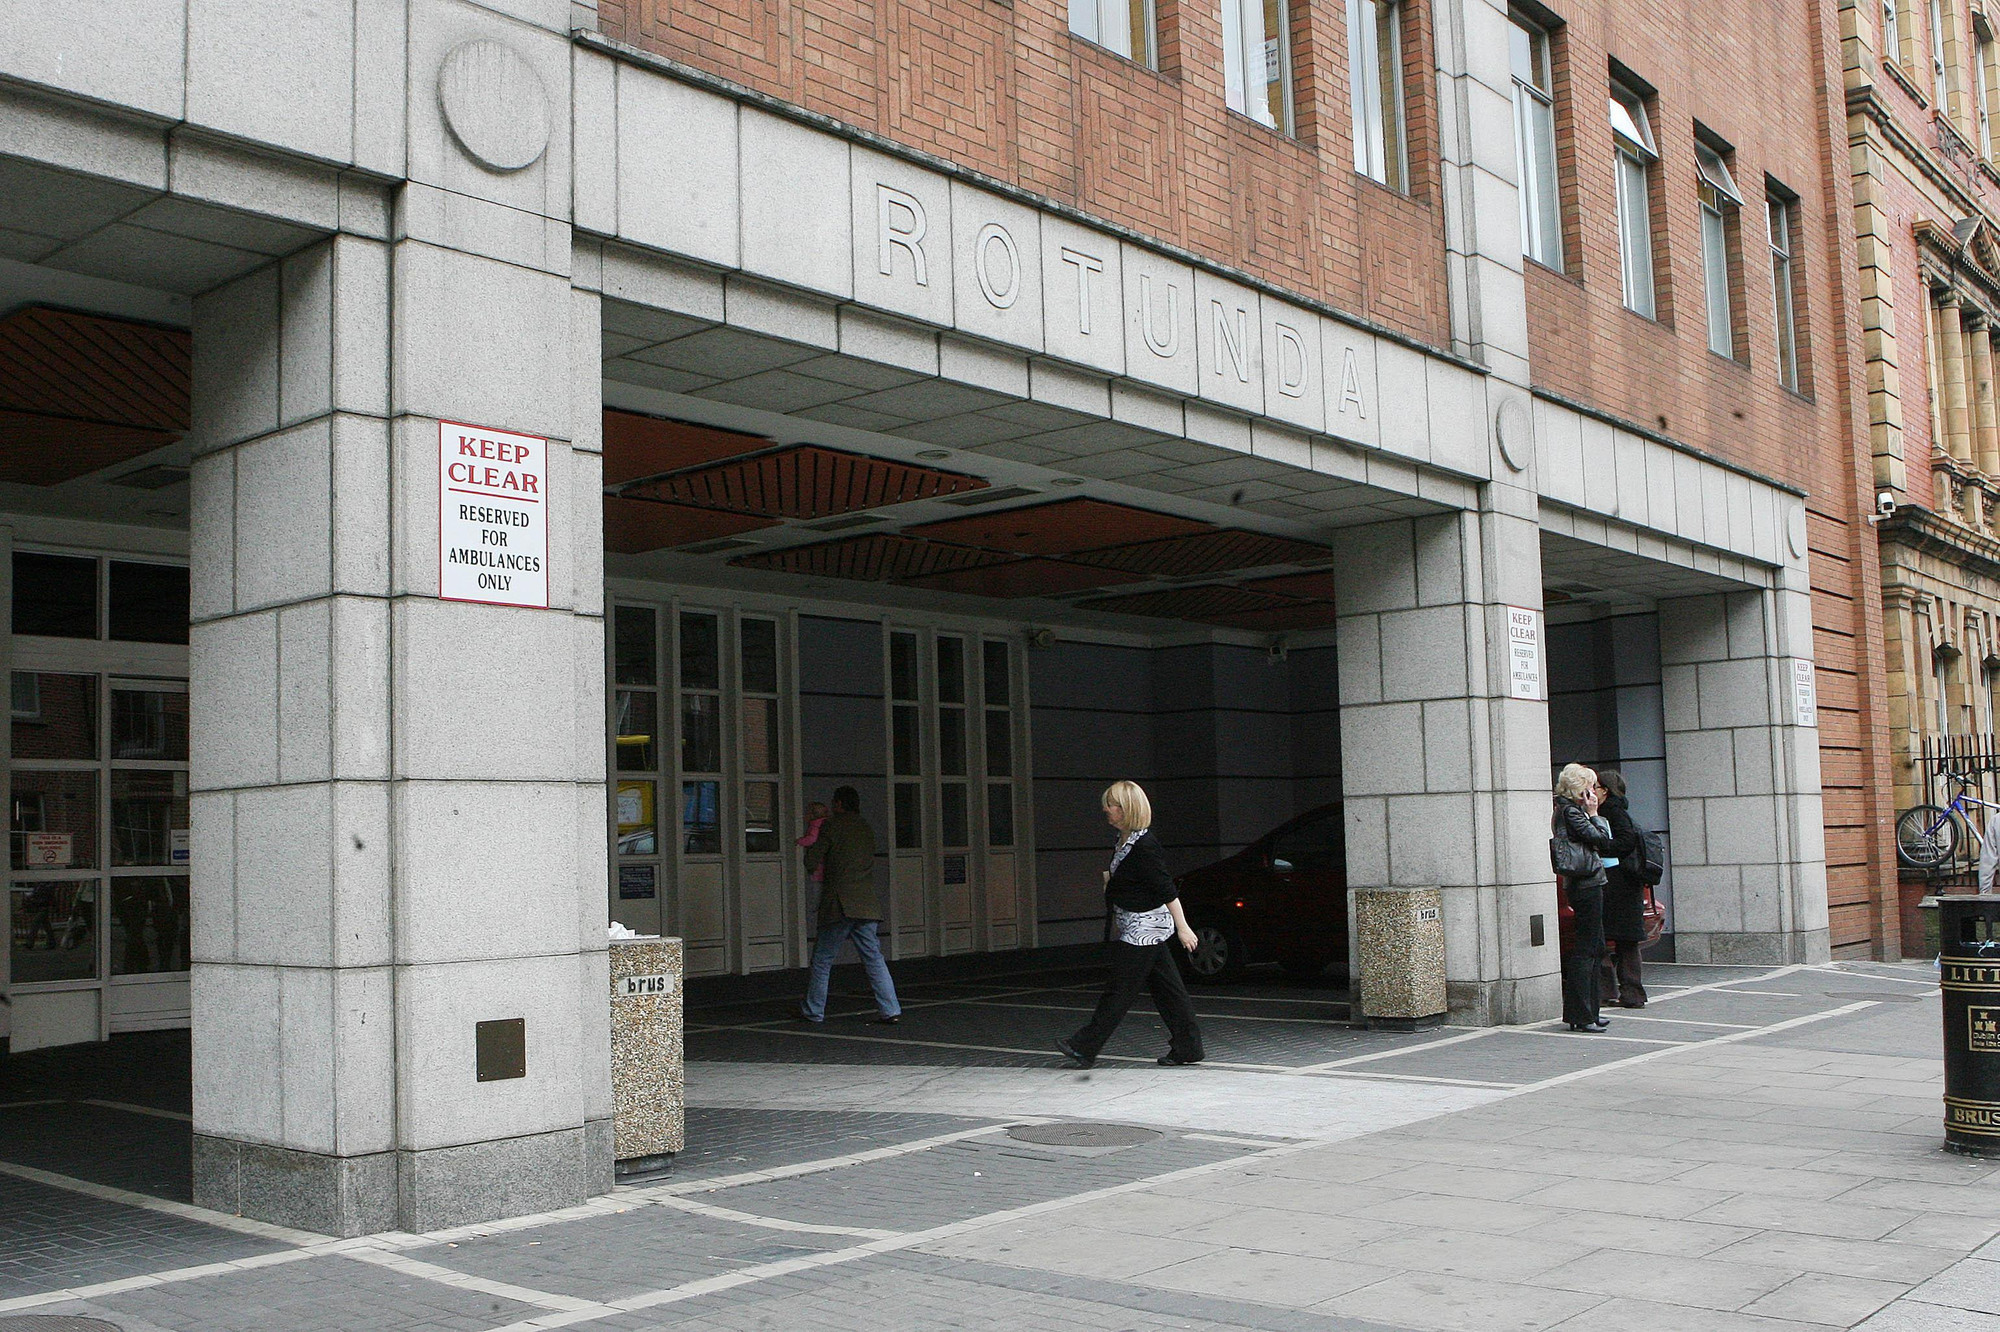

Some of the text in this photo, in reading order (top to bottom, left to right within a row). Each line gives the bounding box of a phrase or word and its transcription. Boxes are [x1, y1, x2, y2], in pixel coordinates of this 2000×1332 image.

[876, 183, 1366, 420] ROTUNDA
[458, 435, 530, 464] KEEP
[448, 462, 539, 494] CLEAR
[459, 504, 530, 528] RESERVED
[481, 529, 508, 547] FOR
[448, 547, 540, 573] AMBULANCES
[477, 573, 512, 591] ONLY
[1512, 612, 1533, 626] KEEP
[1510, 626, 1536, 641] CLEAR
[1514, 648, 1534, 659] RESERVED
[1520, 660, 1529, 670] FOR
[1796, 673, 1810, 682] CLEAR
[1420, 909, 1436, 920] brus
[627, 976, 665, 994] brus
